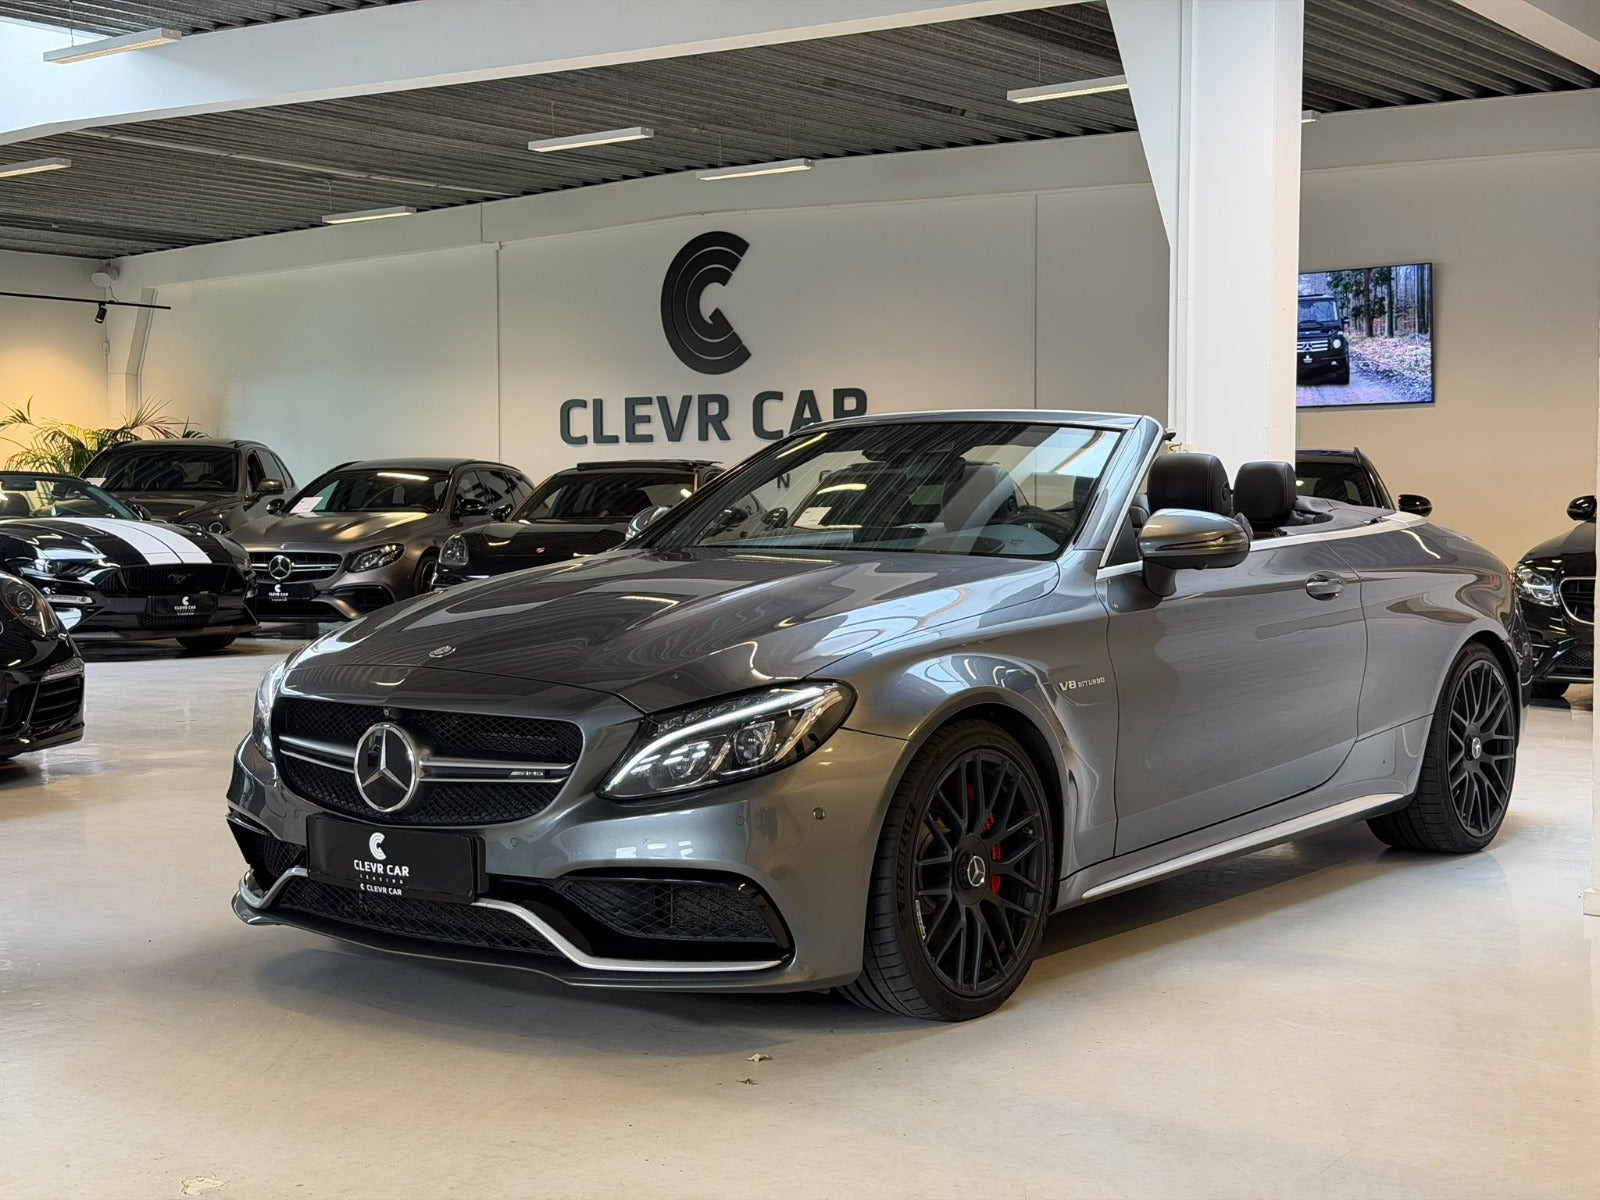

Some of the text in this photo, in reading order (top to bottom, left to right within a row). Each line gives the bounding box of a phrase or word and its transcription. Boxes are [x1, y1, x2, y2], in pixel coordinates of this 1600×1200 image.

[559, 393, 732, 445] CLEVR
[1058, 676, 1105, 691] V8 BITURBO
[353, 859, 410, 877] CLEVR CAR
[366, 884, 387, 894] CLEVR
[388, 887, 402, 896] CAR
